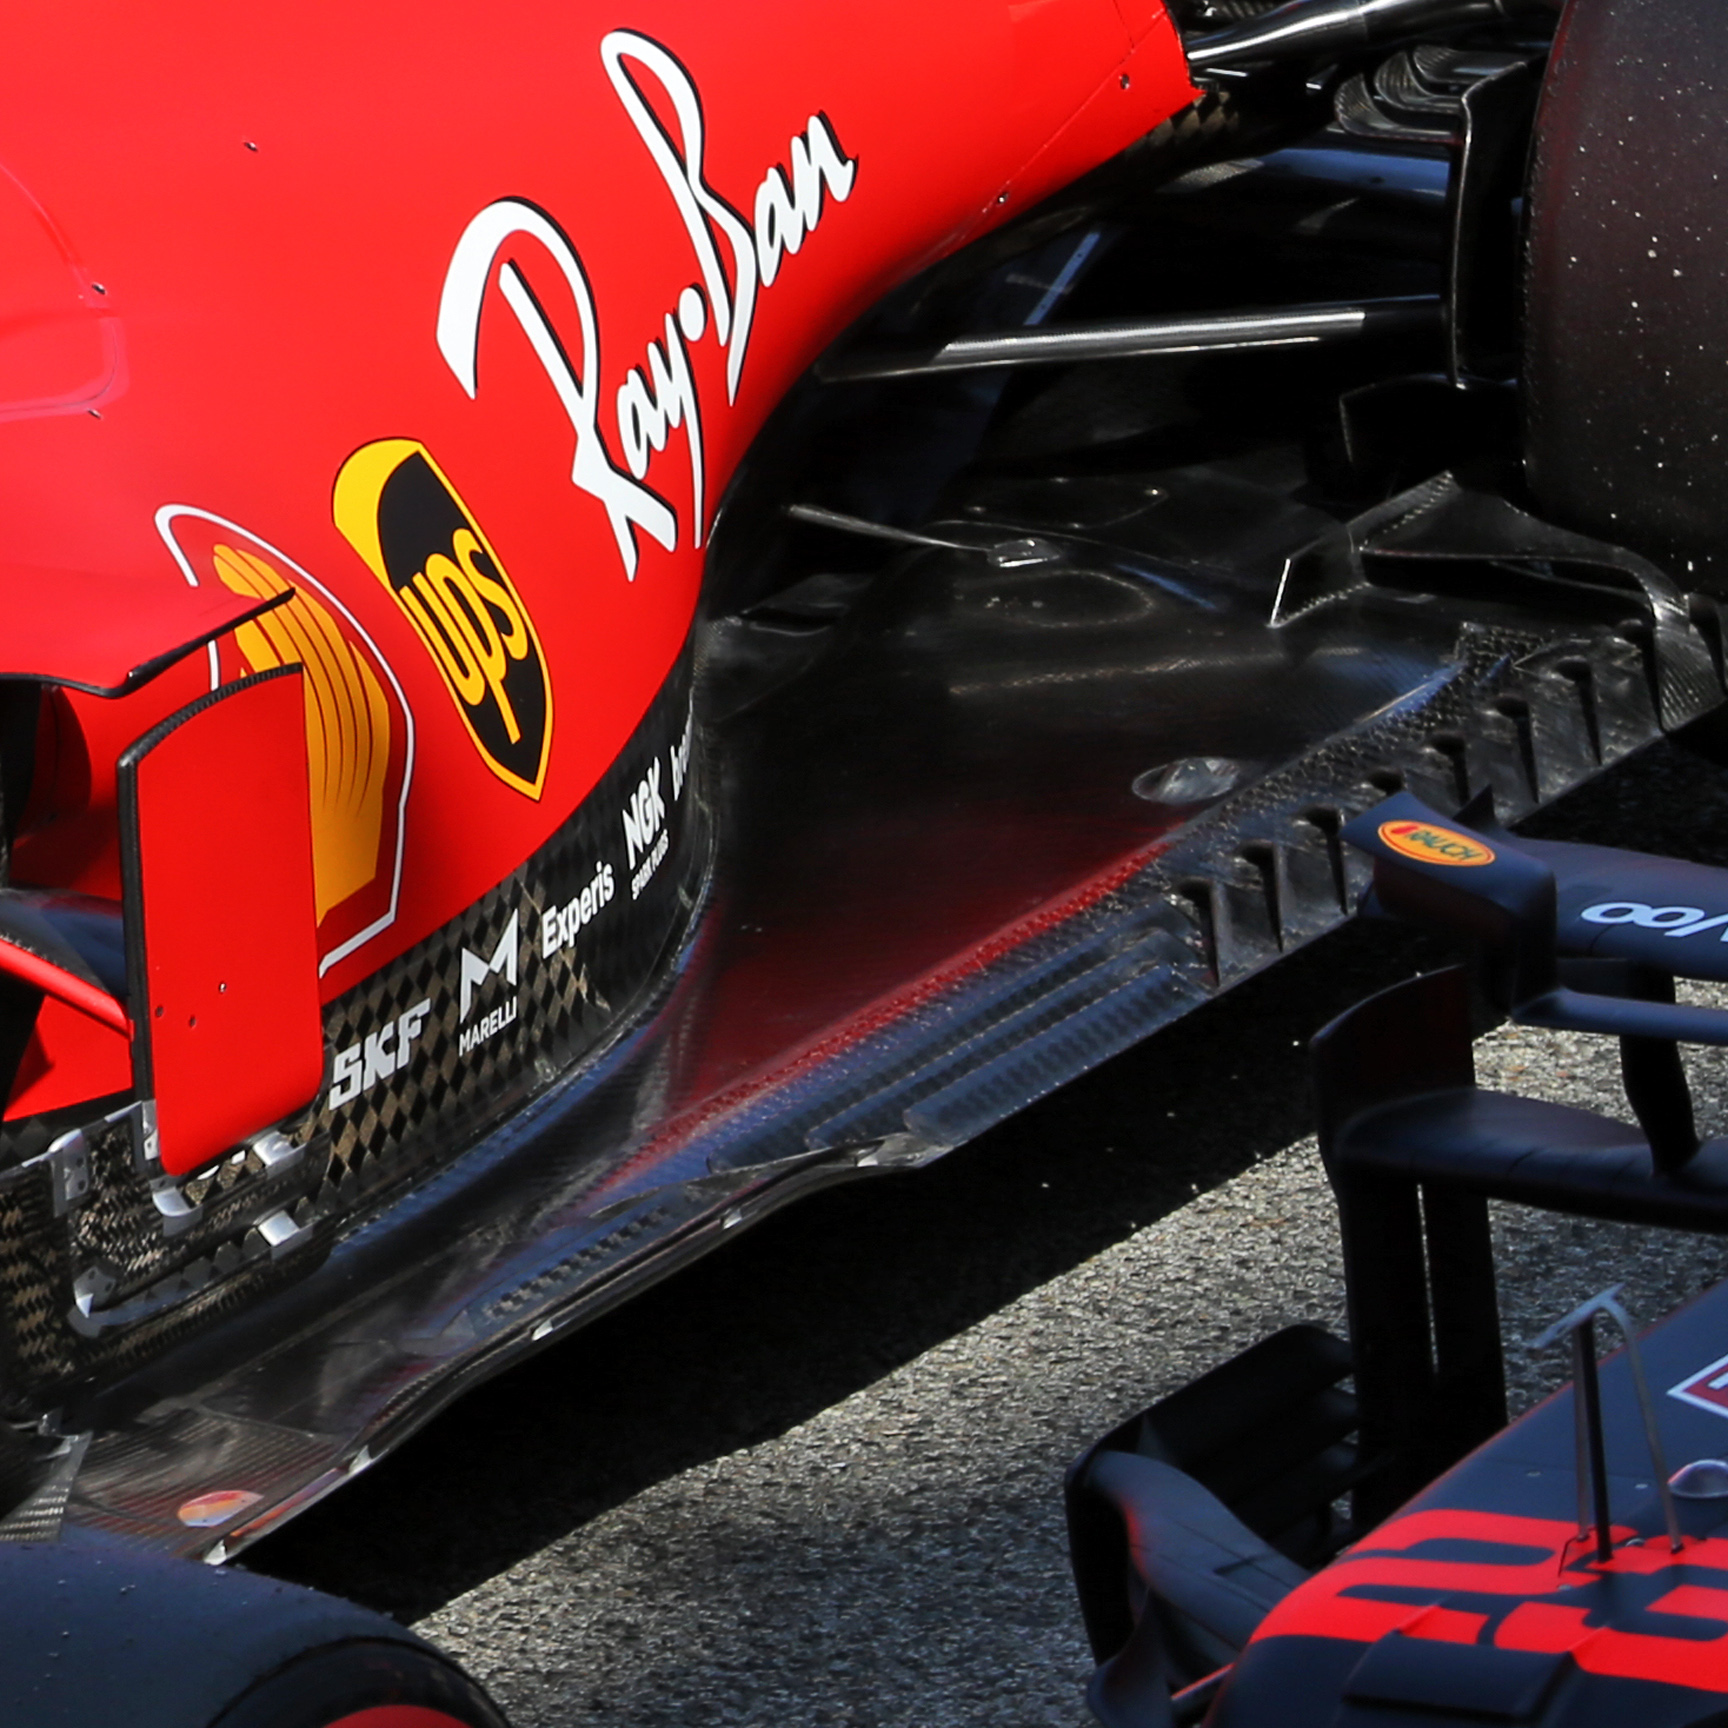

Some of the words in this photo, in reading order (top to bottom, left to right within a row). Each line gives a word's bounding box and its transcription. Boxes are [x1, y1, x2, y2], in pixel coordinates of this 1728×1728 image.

[397, 527, 523, 745] ups
[622, 757, 665, 871] NGK
[541, 860, 616, 960] Experis
[328, 997, 432, 1112] SKF
[458, 995, 518, 1057] MARELLI
